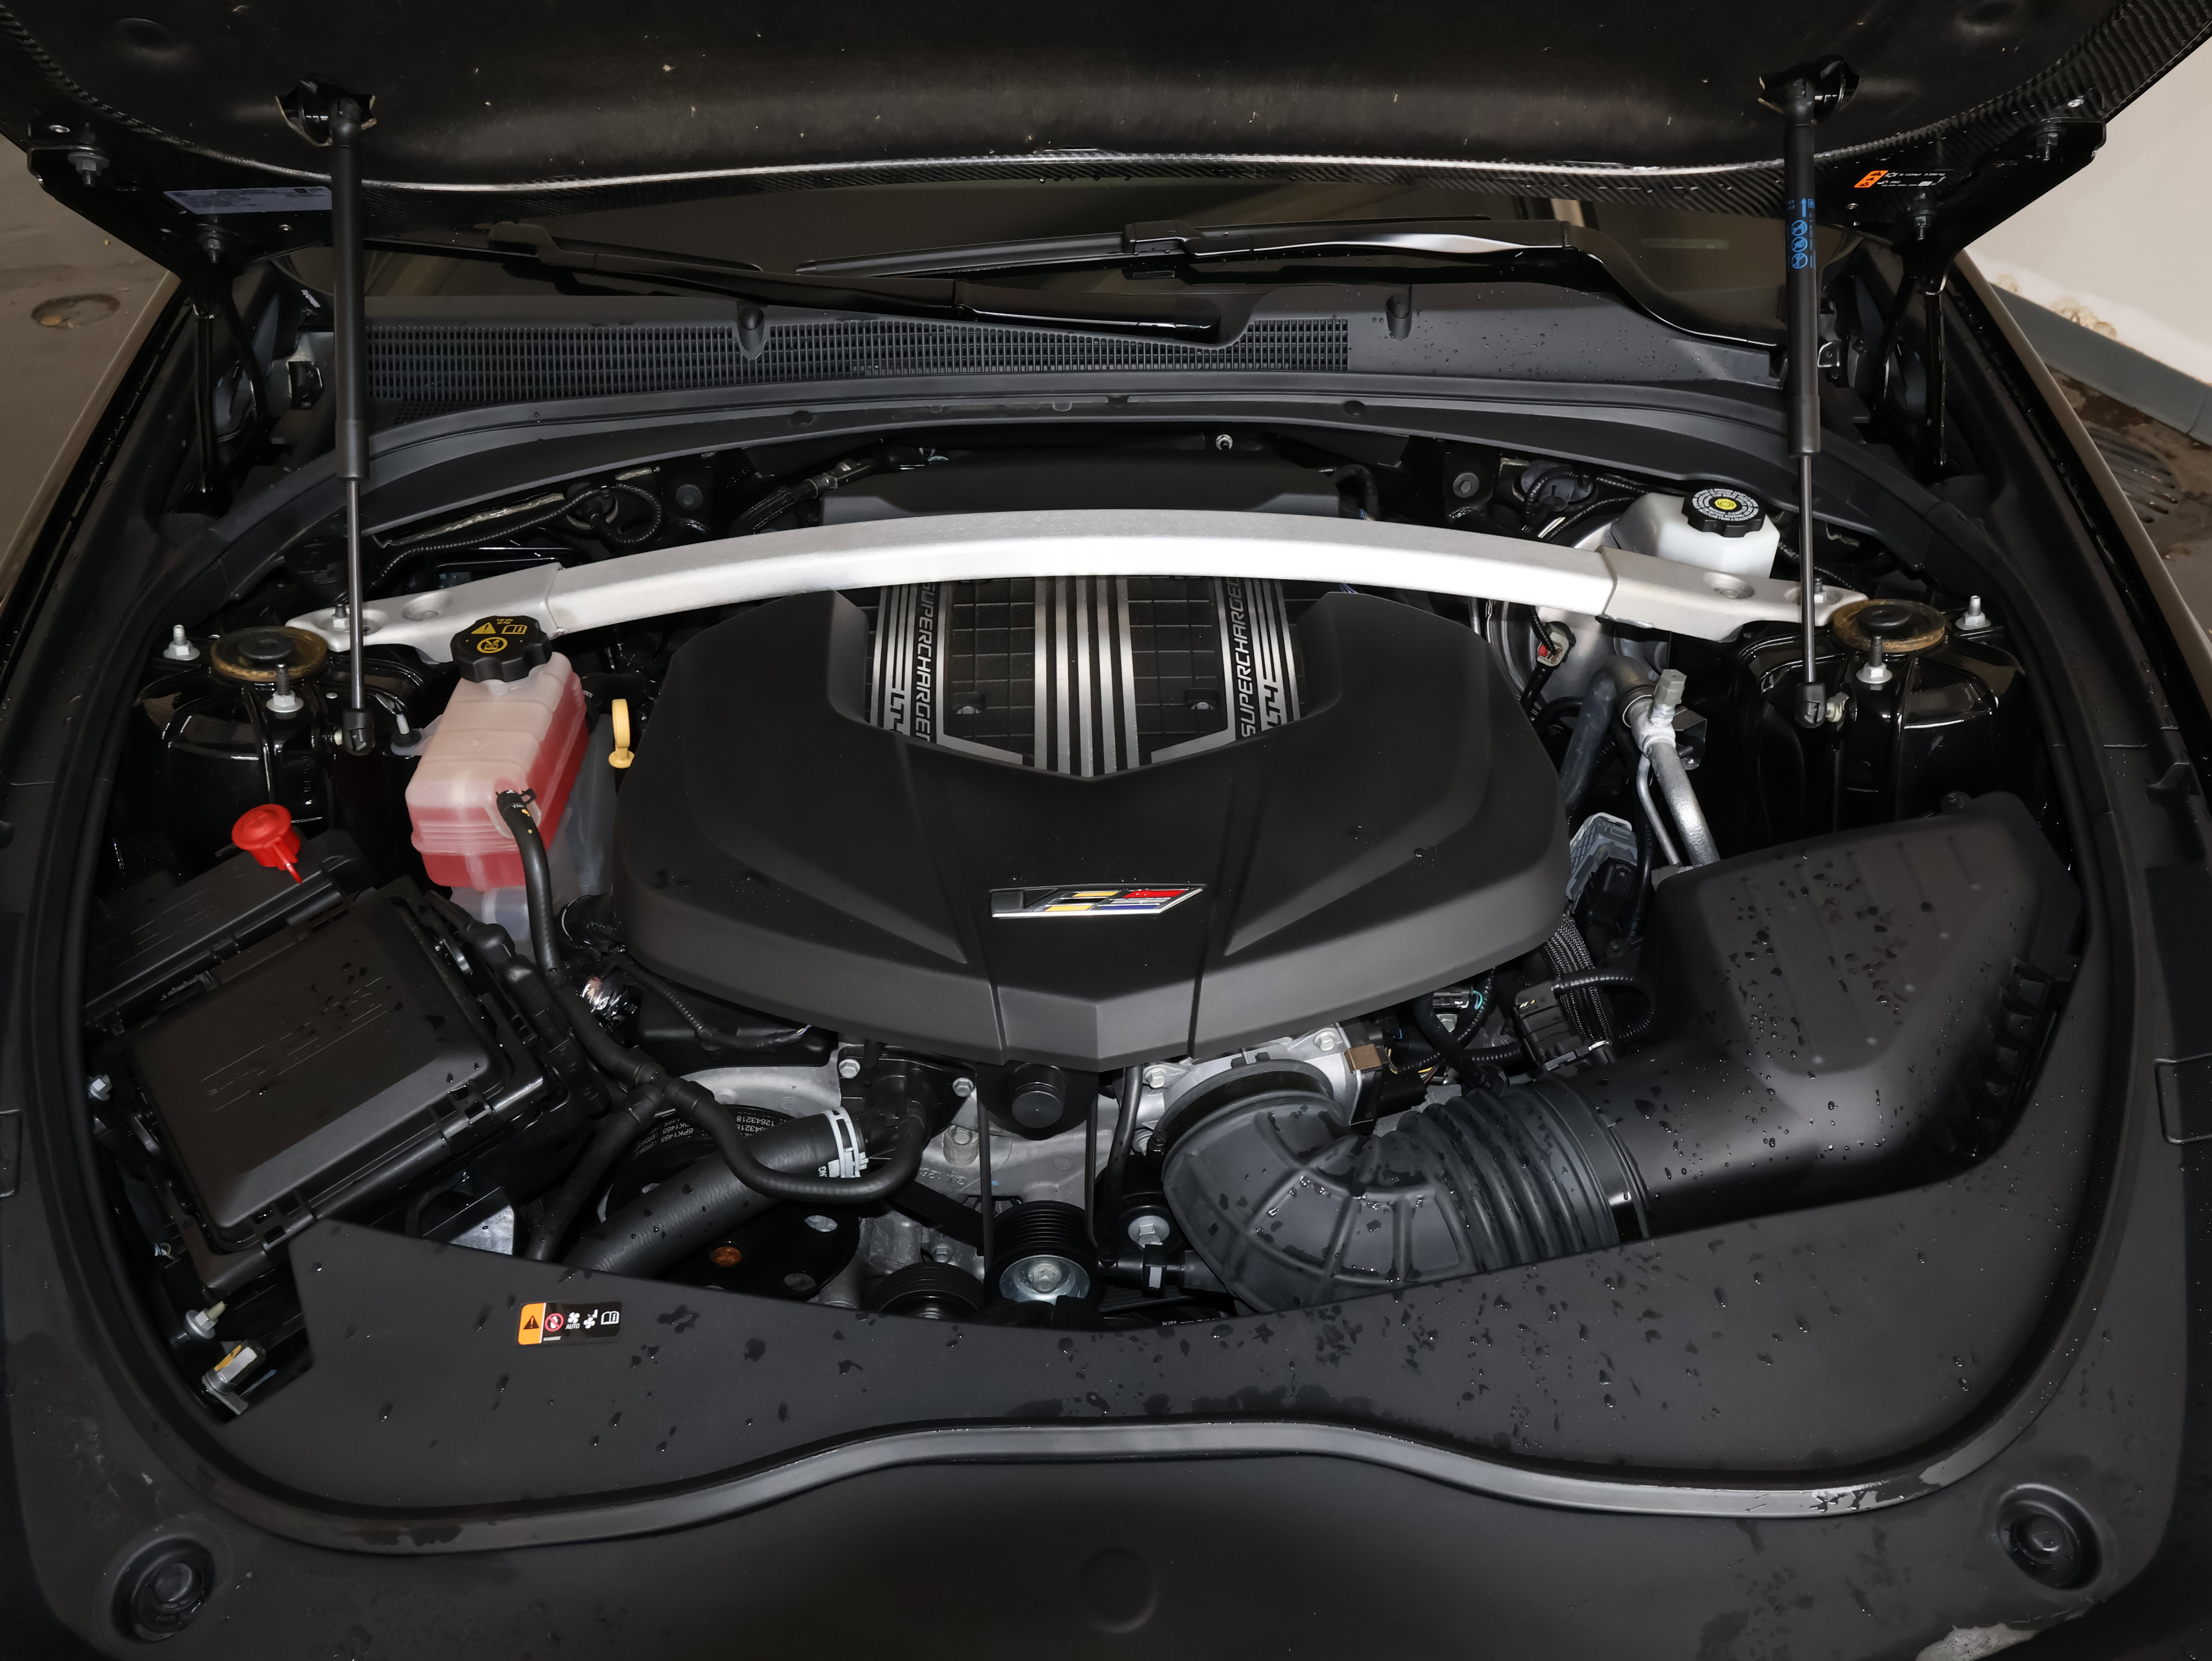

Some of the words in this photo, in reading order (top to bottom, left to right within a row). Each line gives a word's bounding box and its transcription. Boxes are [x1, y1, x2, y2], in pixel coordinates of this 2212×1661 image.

[889, 691, 905, 735] LT4
[1264, 684, 1282, 727] LT4
[660, 1128, 694, 1143] 6PK1465
[737, 1115, 775, 1127] 12643218
